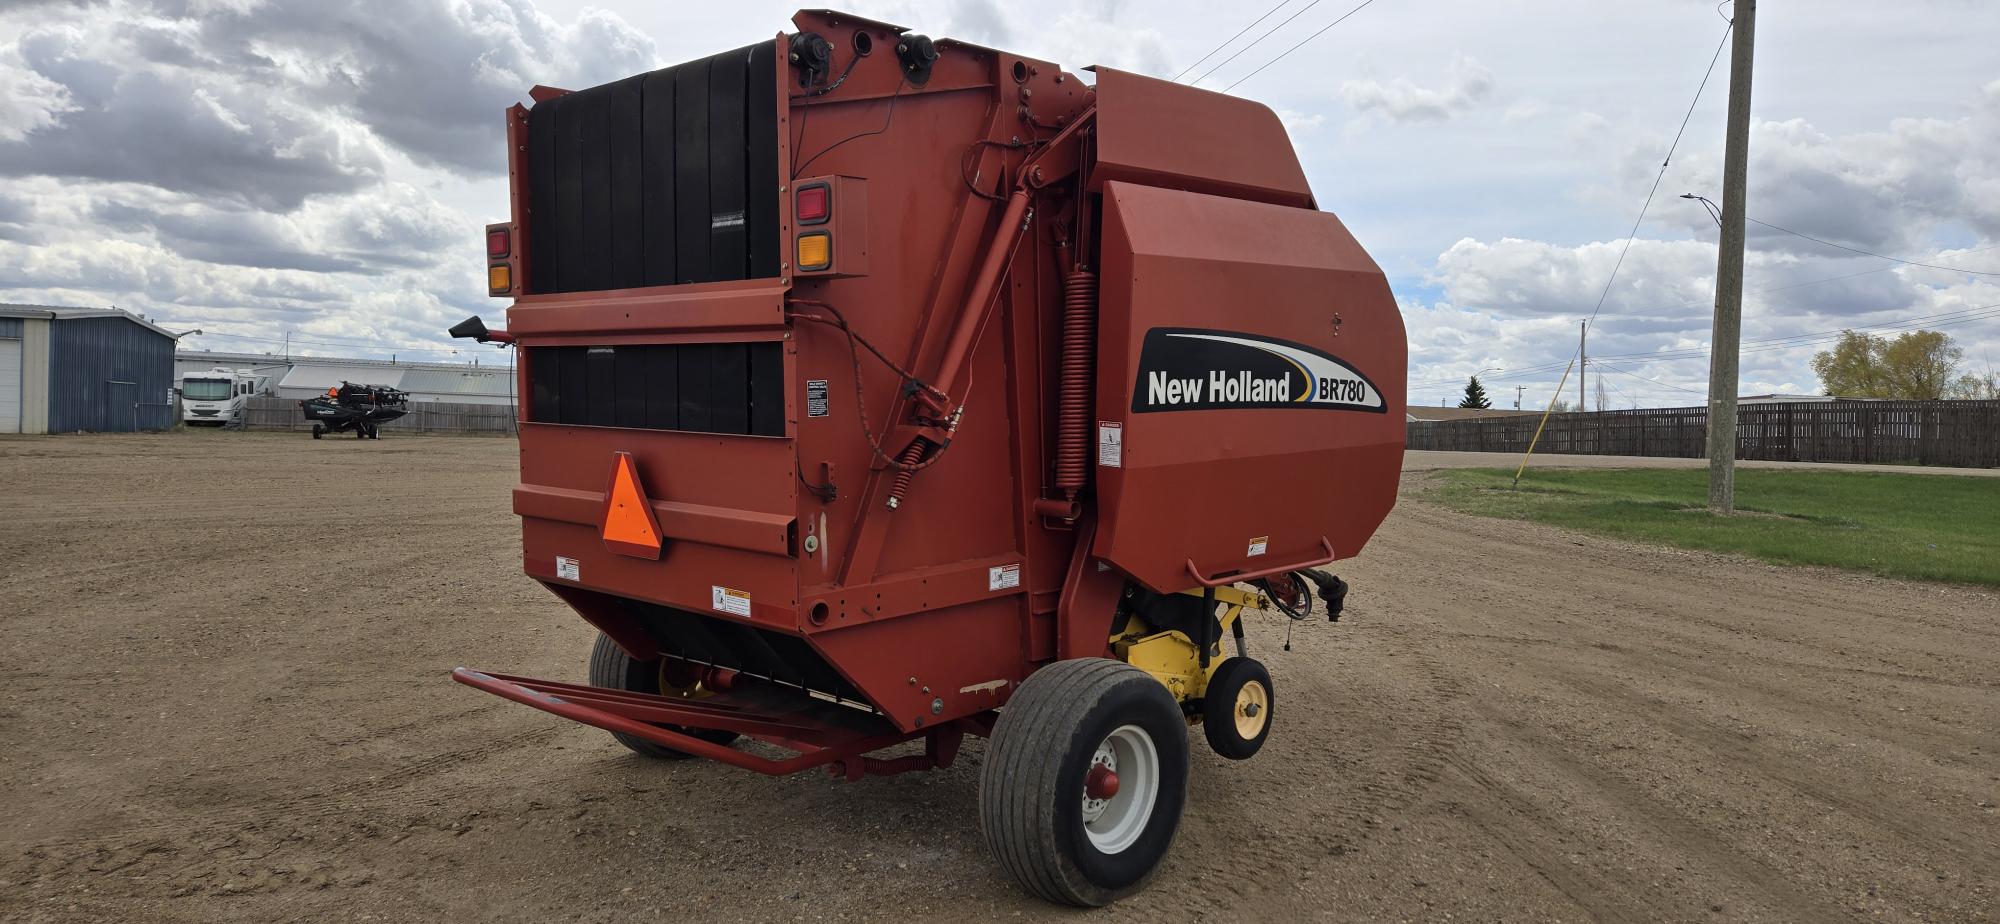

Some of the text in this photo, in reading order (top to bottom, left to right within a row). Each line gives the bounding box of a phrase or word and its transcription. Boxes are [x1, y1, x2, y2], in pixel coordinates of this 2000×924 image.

[1148, 371, 1290, 405] New Holland
[1319, 377, 1365, 402] BR780
